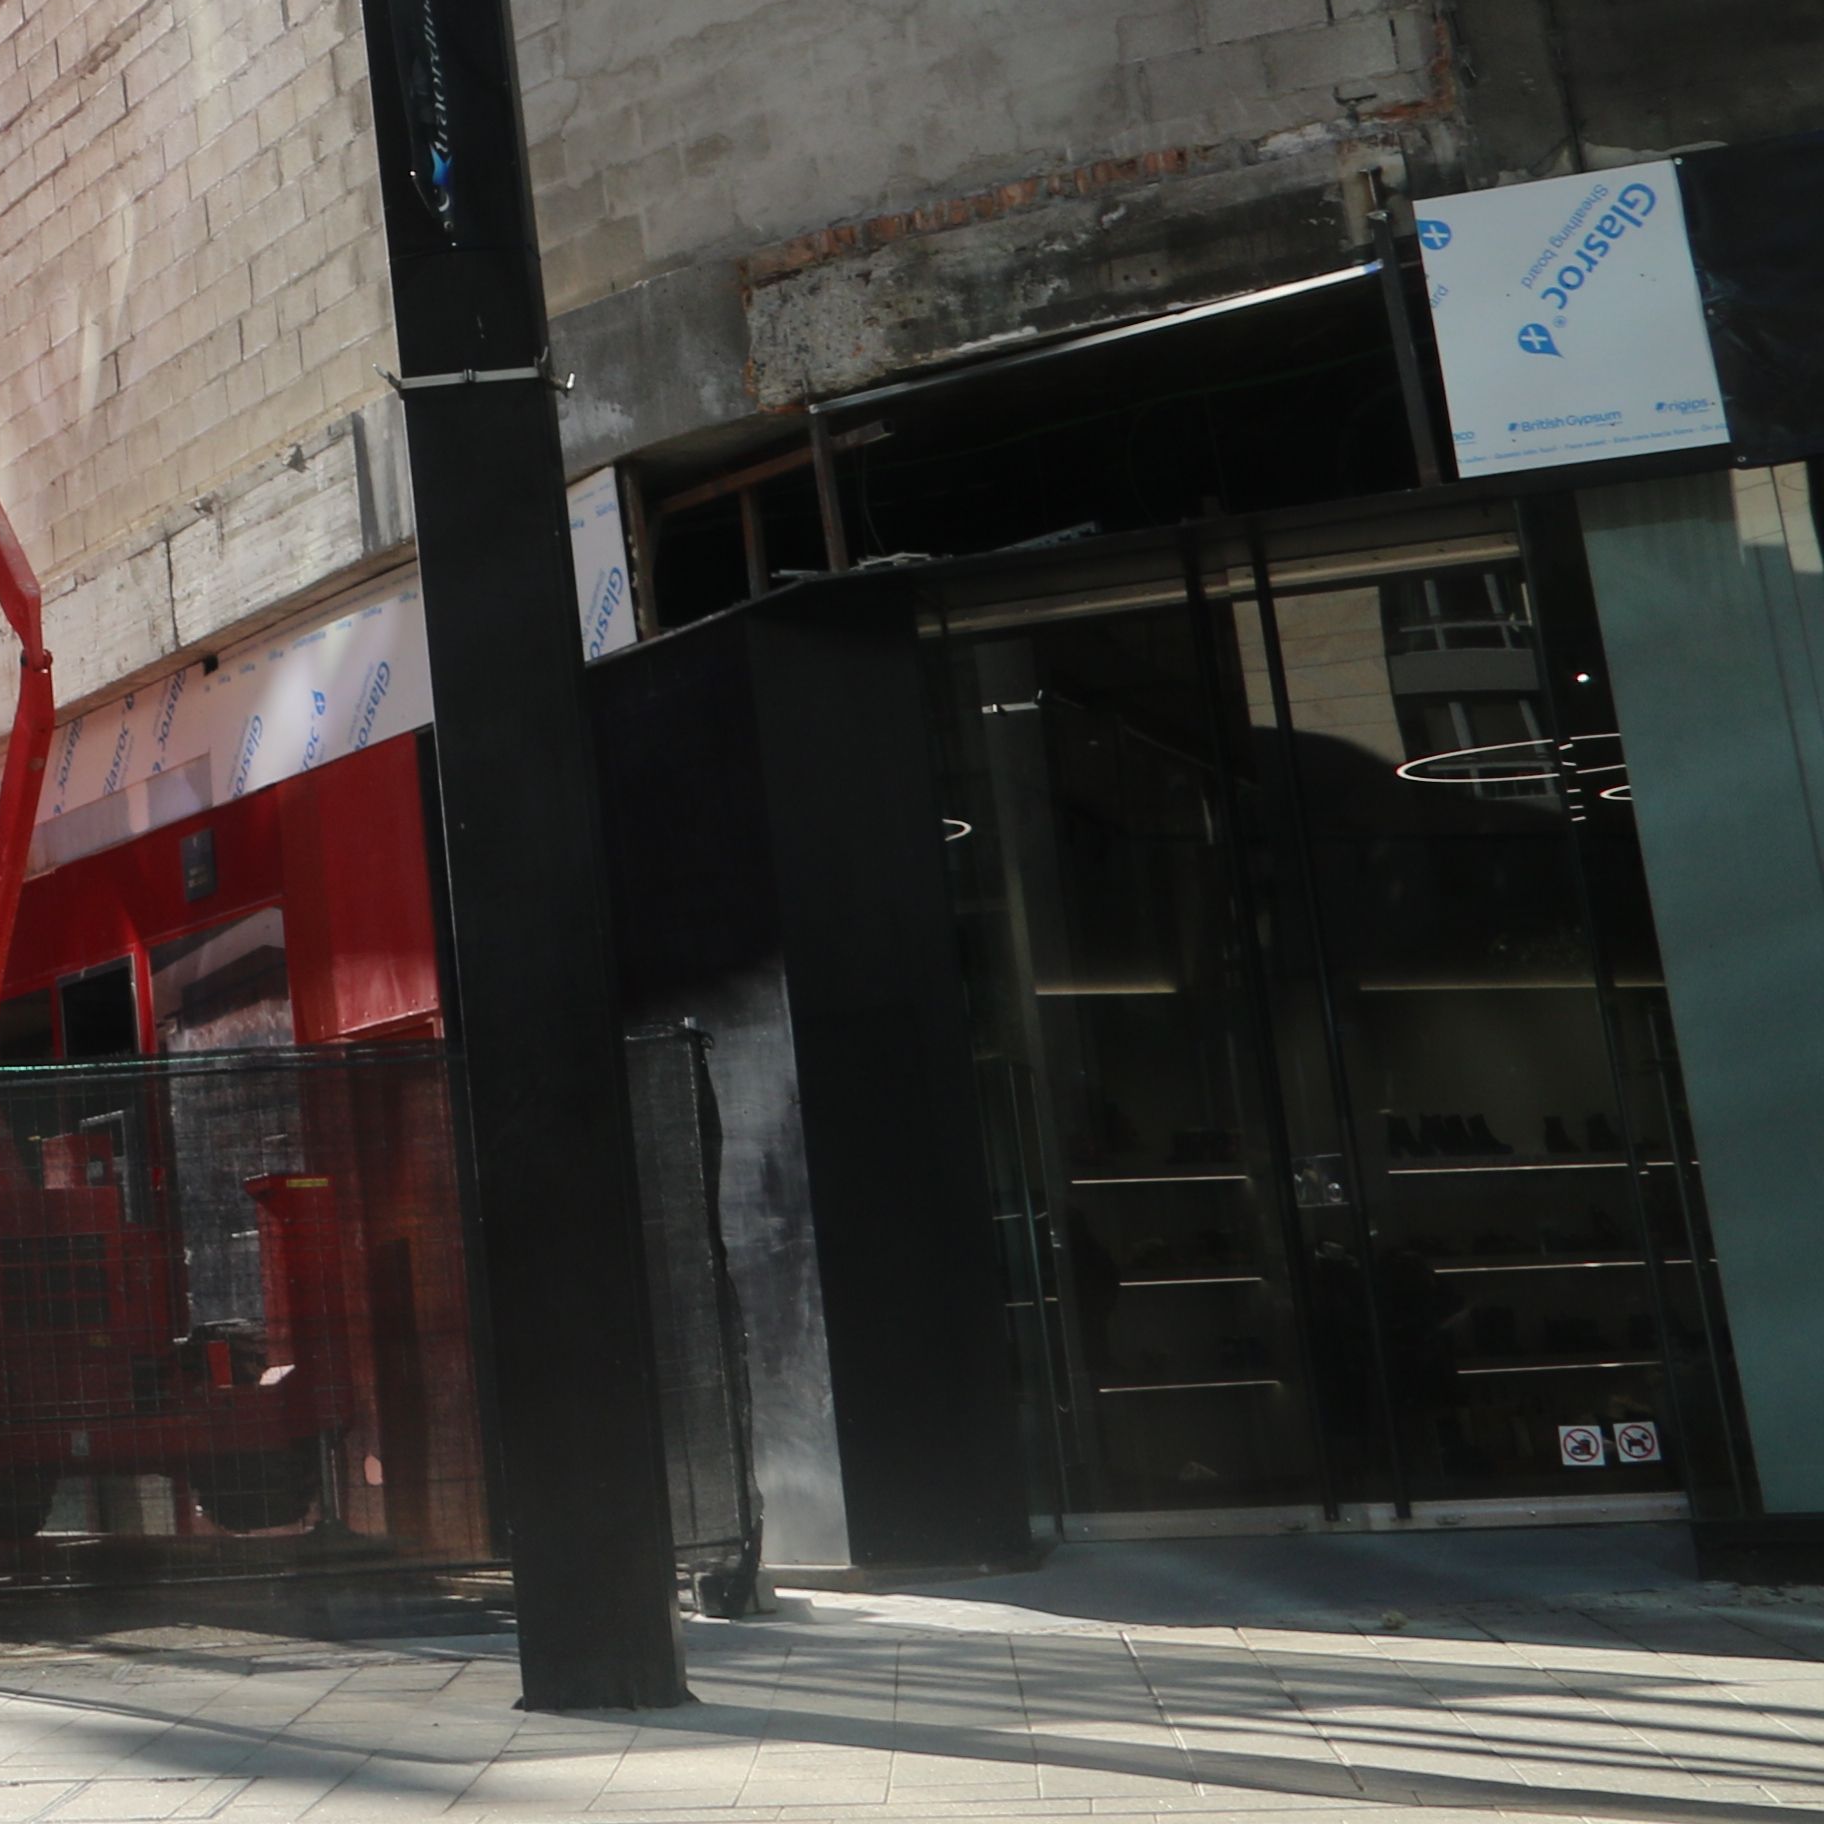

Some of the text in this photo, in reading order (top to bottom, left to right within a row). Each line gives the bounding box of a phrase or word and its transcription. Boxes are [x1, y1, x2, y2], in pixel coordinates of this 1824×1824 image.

[1540, 181, 1657, 311] Glasroc
[1521, 409, 1623, 433] British Gypsum
